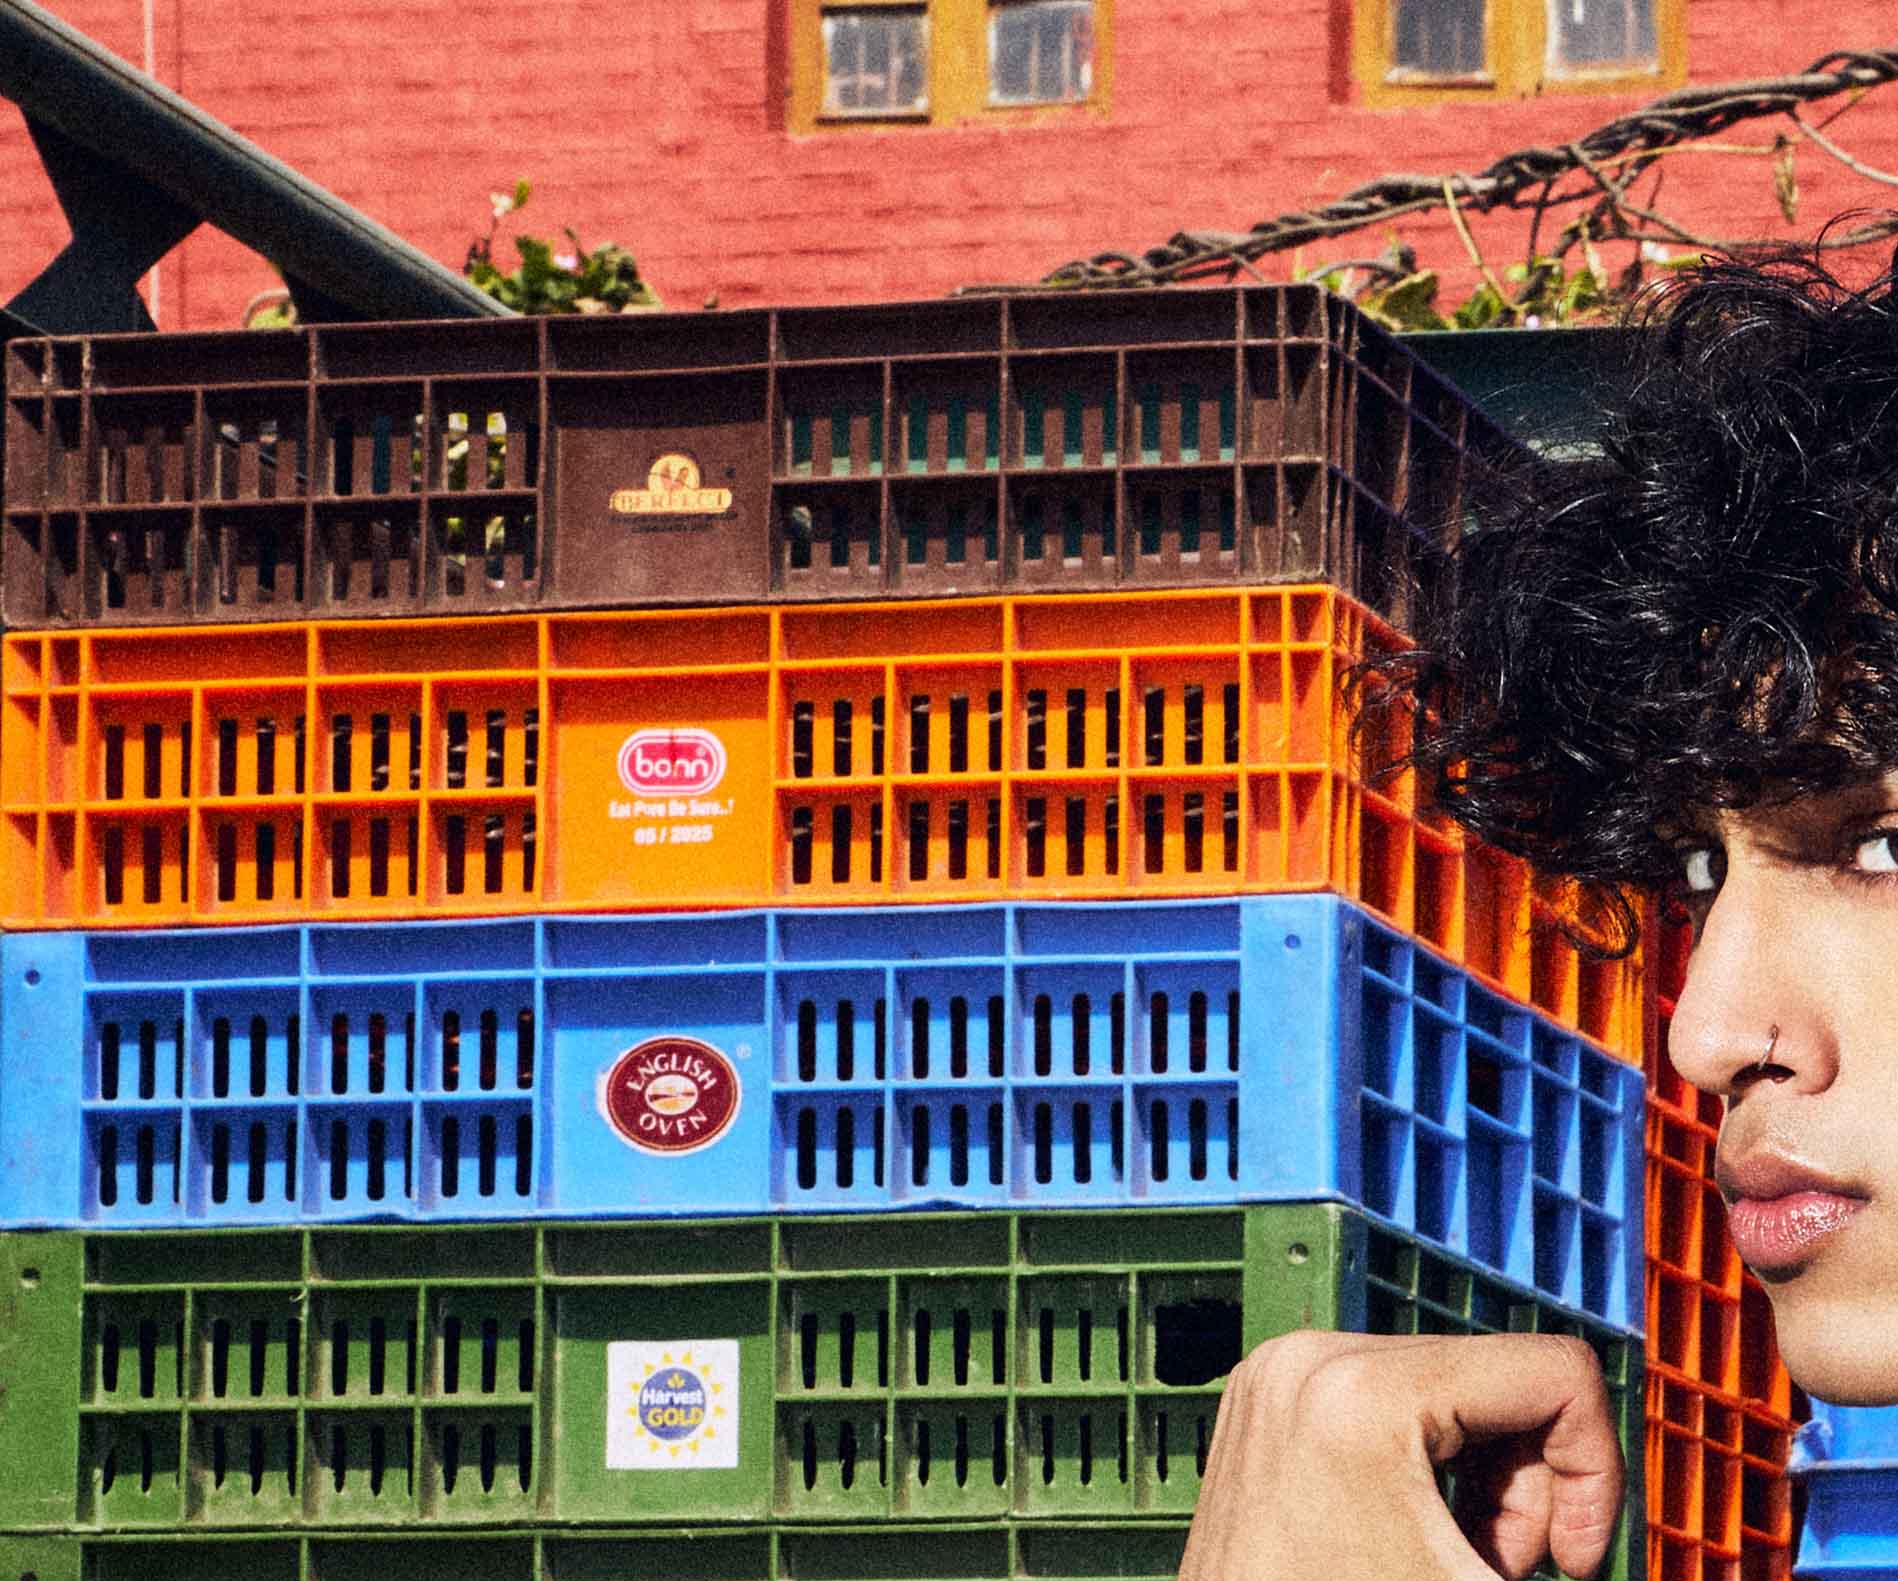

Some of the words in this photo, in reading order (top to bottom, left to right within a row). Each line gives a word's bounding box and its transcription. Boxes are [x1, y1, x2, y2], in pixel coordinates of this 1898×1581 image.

[635, 747, 709, 778] bonn
[626, 1053, 717, 1091] ENGLISH
[640, 1108, 707, 1136] OVEN
[642, 1389, 704, 1405] Harvest
[648, 1407, 704, 1426] GOLD
